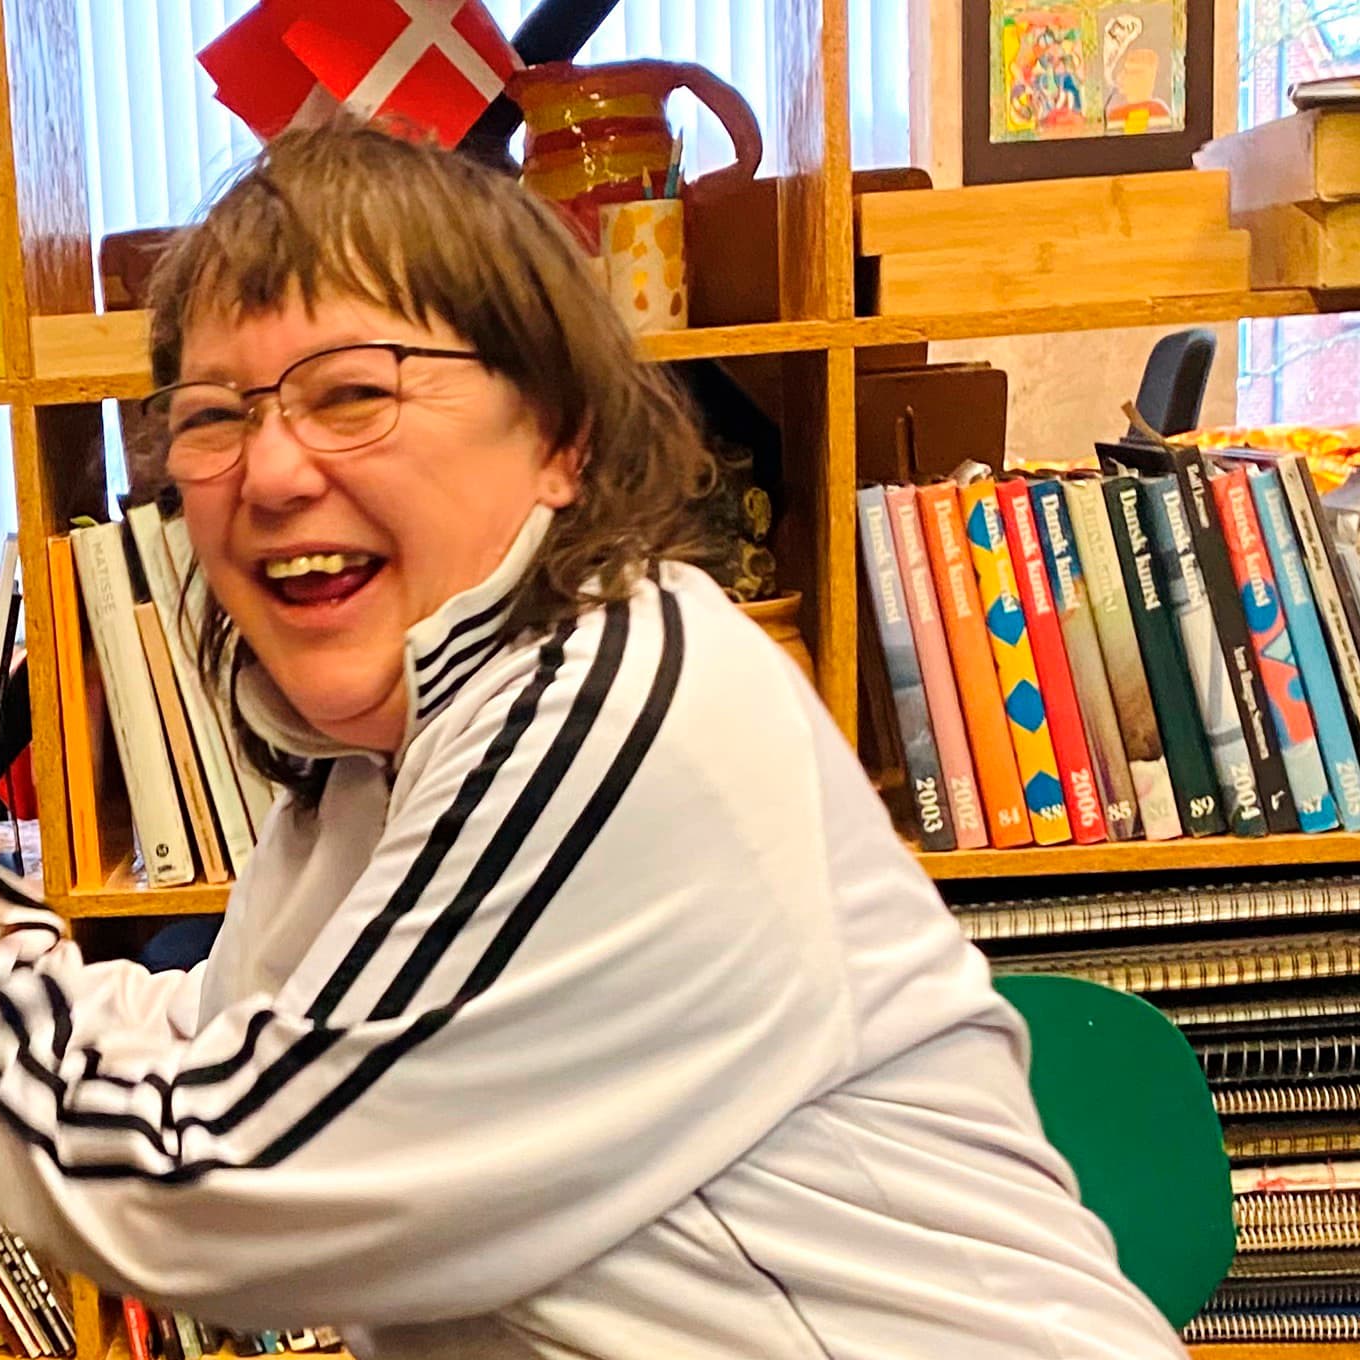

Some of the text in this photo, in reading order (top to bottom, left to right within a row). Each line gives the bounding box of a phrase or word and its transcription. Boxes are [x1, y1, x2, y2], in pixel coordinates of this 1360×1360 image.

[866, 505, 892, 569] Dansk
[898, 505, 935, 625] Dansk kunst
[934, 499, 973, 619] Dansk kunst
[1012, 496, 1050, 615] Dansk kunst
[1042, 493, 1081, 611] Dansk kunst
[1120, 488, 1161, 611] Dansk kunst
[1162, 490, 1205, 609] Dansk kunst
[1228, 485, 1271, 607] Dansk kunst
[93, 541, 117, 616] MATISSE
[916, 777, 943, 833] 2003
[951, 776, 979, 829] 2002
[998, 807, 1021, 827] 84
[1040, 804, 1064, 821] 88
[1072, 768, 1099, 827] 2006
[1107, 800, 1132, 821] 85
[1190, 795, 1214, 818] 89
[1230, 763, 1261, 820] 2004
[1303, 796, 1322, 814] 87
[1336, 760, 1359, 815] 2005
